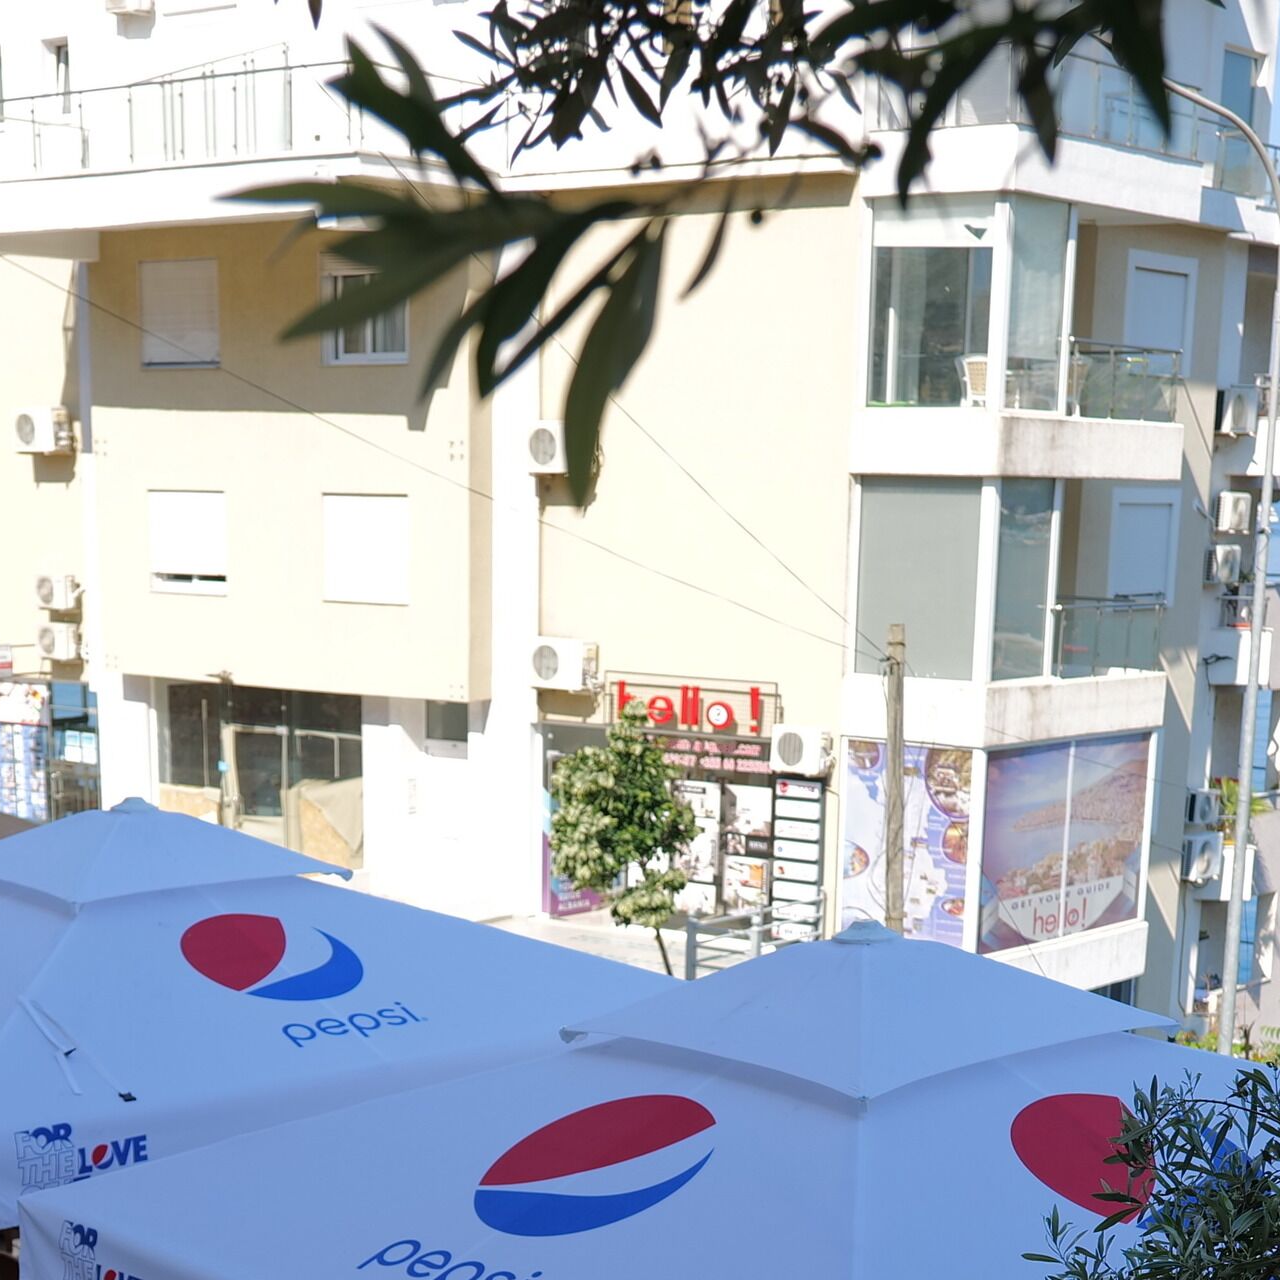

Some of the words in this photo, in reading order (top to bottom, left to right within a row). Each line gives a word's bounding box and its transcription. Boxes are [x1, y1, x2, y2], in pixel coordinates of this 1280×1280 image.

[1011, 899, 1032, 910] GET
[1077, 881, 1111, 896] GUIDE
[1033, 897, 1087, 935] hello!
[282, 1001, 420, 1048] pepsi
[14, 1122, 75, 1161] FOR
[78, 1134, 148, 1175] LOVE
[59, 1219, 98, 1261] FOR
